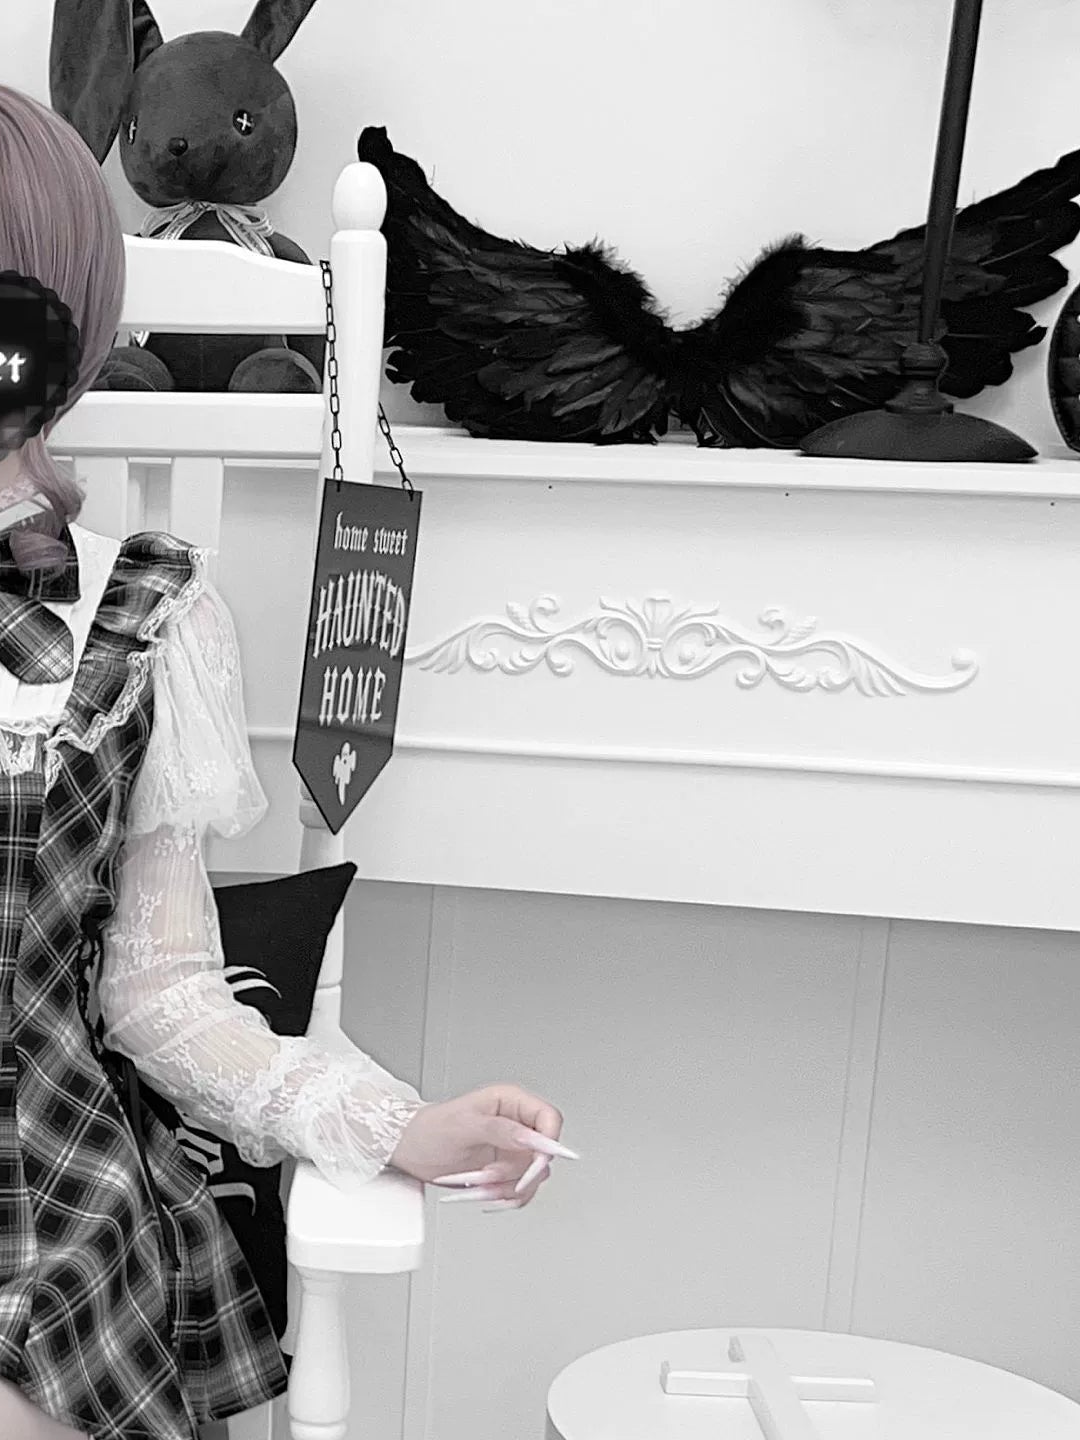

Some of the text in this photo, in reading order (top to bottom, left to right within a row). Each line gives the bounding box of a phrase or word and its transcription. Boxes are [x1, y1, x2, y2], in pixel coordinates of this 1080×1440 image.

[334, 511, 408, 555] home sweet
[314, 569, 405, 658] HAUNTED
[319, 665, 386, 726] HOME
